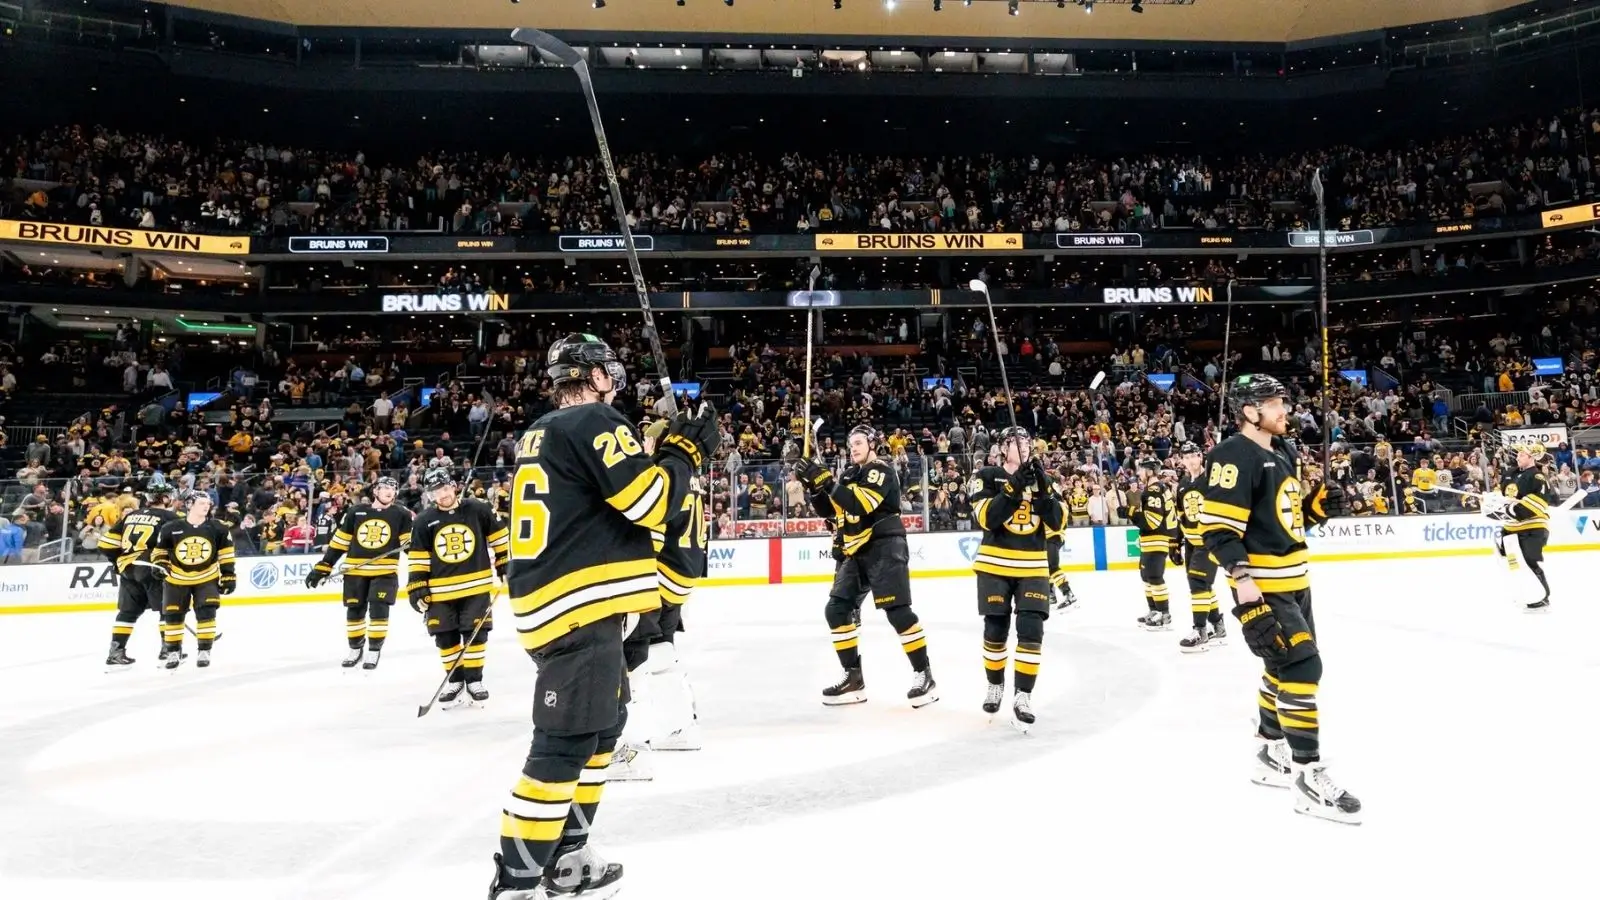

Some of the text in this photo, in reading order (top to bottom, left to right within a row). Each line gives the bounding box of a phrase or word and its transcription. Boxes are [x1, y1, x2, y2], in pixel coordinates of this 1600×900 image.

[18, 223, 201, 251] BRUINS WIN
[481, 240, 494, 248] WIN
[578, 239, 613, 248] BRUINS
[716, 237, 750, 245] BRUINS WIN
[857, 234, 984, 248] BRUINS WIN
[1074, 237, 1124, 245] BRUINS WIN
[1337, 235, 1354, 243] WIN
[309, 240, 368, 249] BRUINS WIN
[1104, 287, 1213, 303] BRUINS WIN
[382, 293, 509, 312] BRUINS WIN
[593, 425, 642, 469] 26
[867, 468, 886, 487] 91
[509, 463, 550, 560] 6
[1318, 524, 1395, 538] SYMETRA
[1024, 591, 1048, 601] CCM
